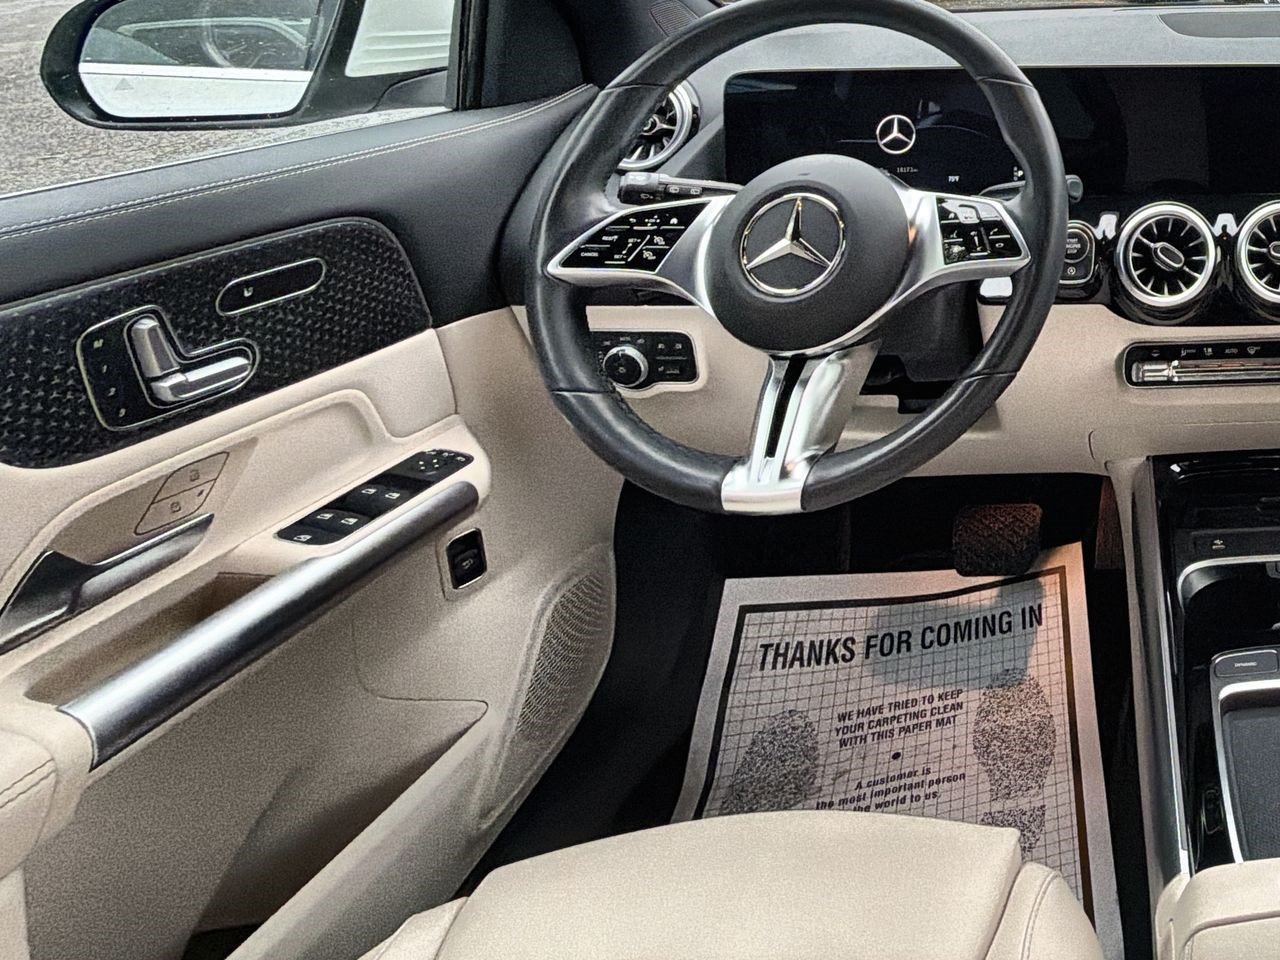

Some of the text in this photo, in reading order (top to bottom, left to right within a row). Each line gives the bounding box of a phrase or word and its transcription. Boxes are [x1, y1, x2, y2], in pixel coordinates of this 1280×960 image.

[759, 603, 1043, 671] THANKS FOR COMING IN
[835, 701, 963, 736] YOUR CARPETING CLEAN
[837, 689, 963, 722] WE HAVE TRIED TO KEEP
[840, 715, 958, 748] WITH THIS PAPER MAT
[815, 772, 966, 811] the most important person
[855, 766, 931, 790] A customer is
[874, 794, 906, 810] world
[910, 793, 921, 803] to
